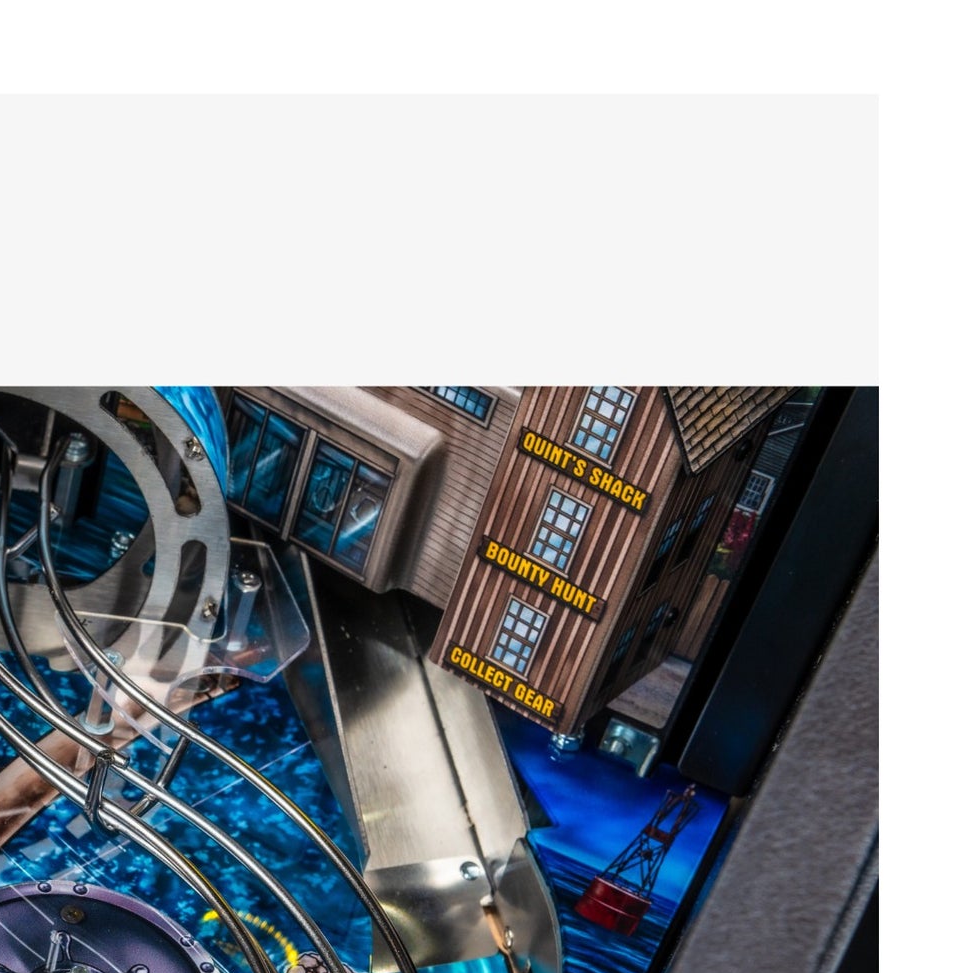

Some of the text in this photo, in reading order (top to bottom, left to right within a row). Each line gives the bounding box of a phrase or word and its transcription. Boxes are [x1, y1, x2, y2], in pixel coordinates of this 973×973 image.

[522, 431, 647, 510] QUINT'S SHACK
[485, 540, 598, 614] BOUNTY HUNT
[450, 646, 555, 718] COLLECT GEAR
